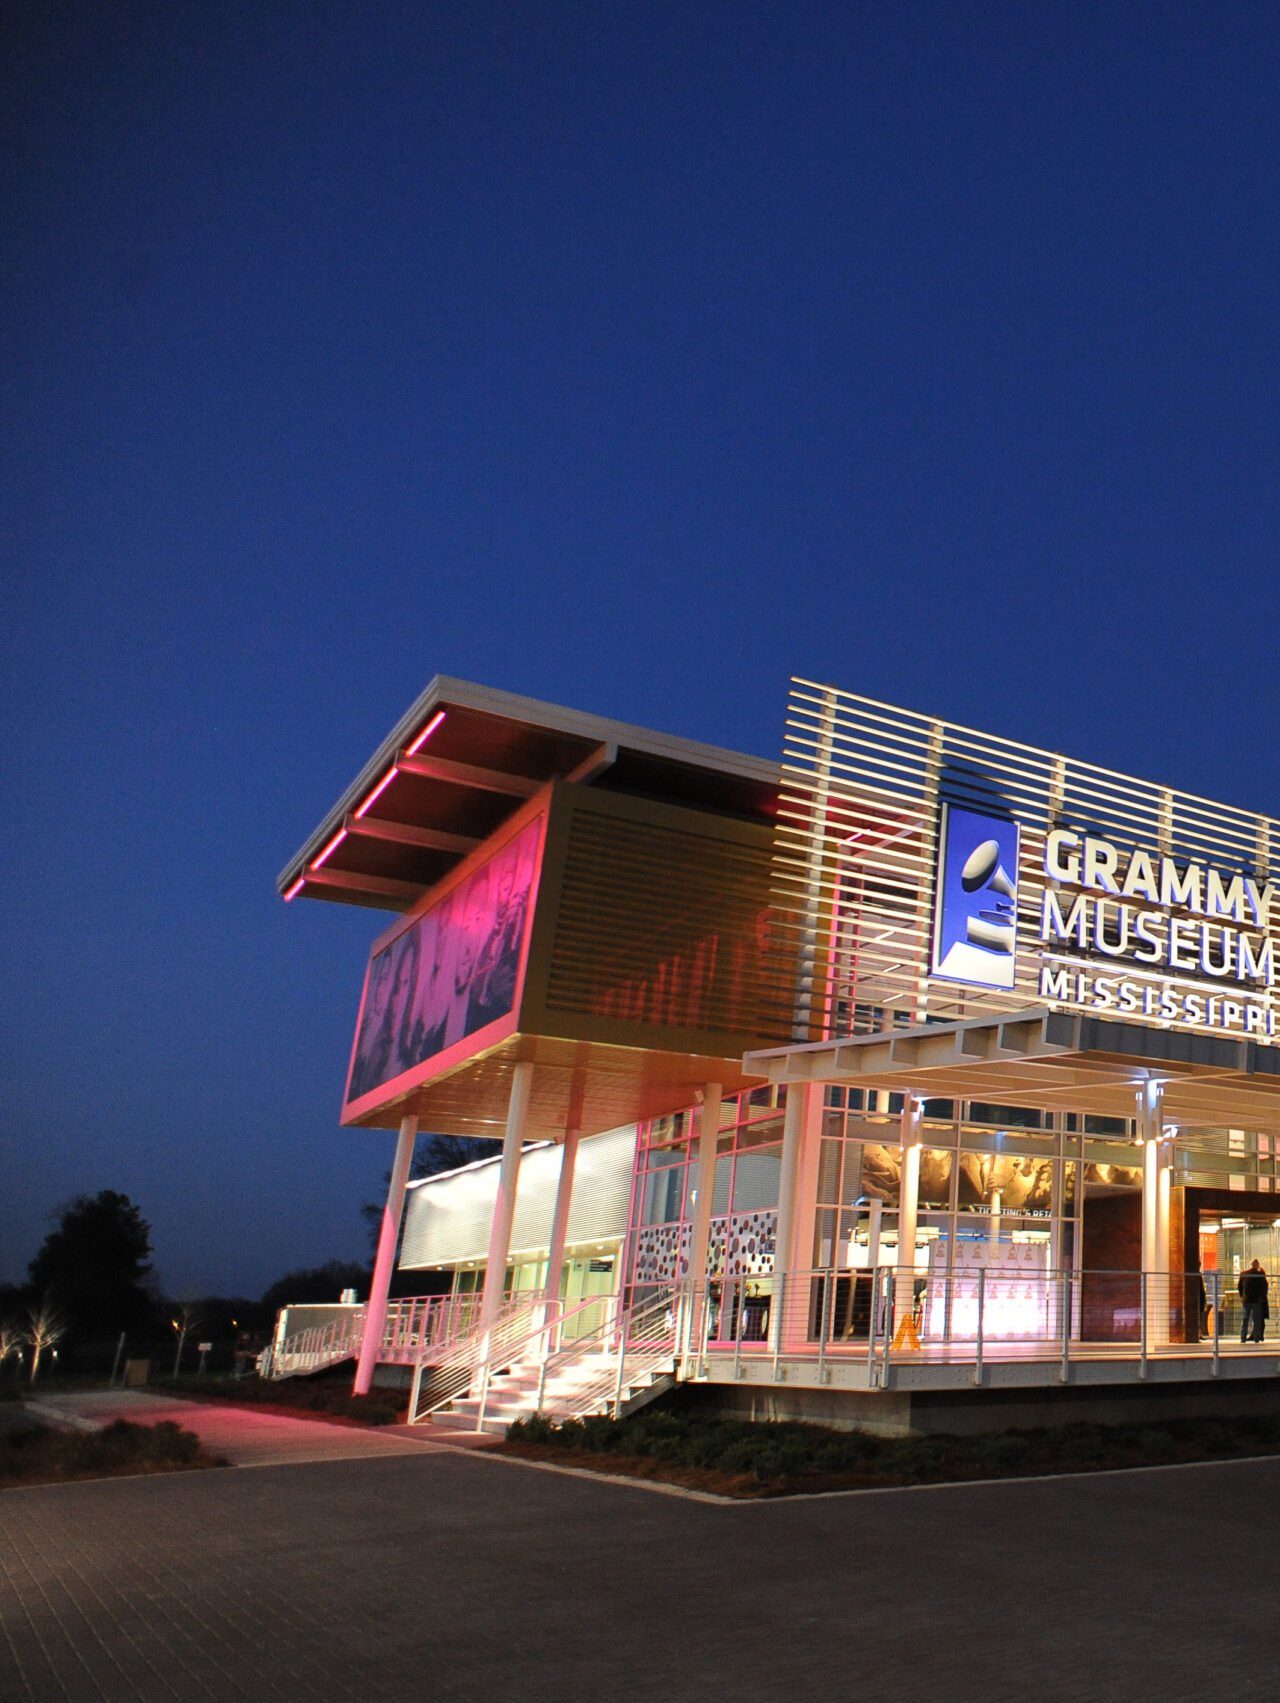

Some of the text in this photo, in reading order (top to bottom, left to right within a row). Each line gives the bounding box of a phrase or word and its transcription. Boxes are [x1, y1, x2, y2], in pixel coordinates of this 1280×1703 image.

[1044, 830, 1275, 927] GRAMMY
[1040, 889, 1275, 985] MUSEUM
[1039, 967, 1275, 1035] MISSISSIPPI
[977, 1206, 1022, 1216] TICTING
